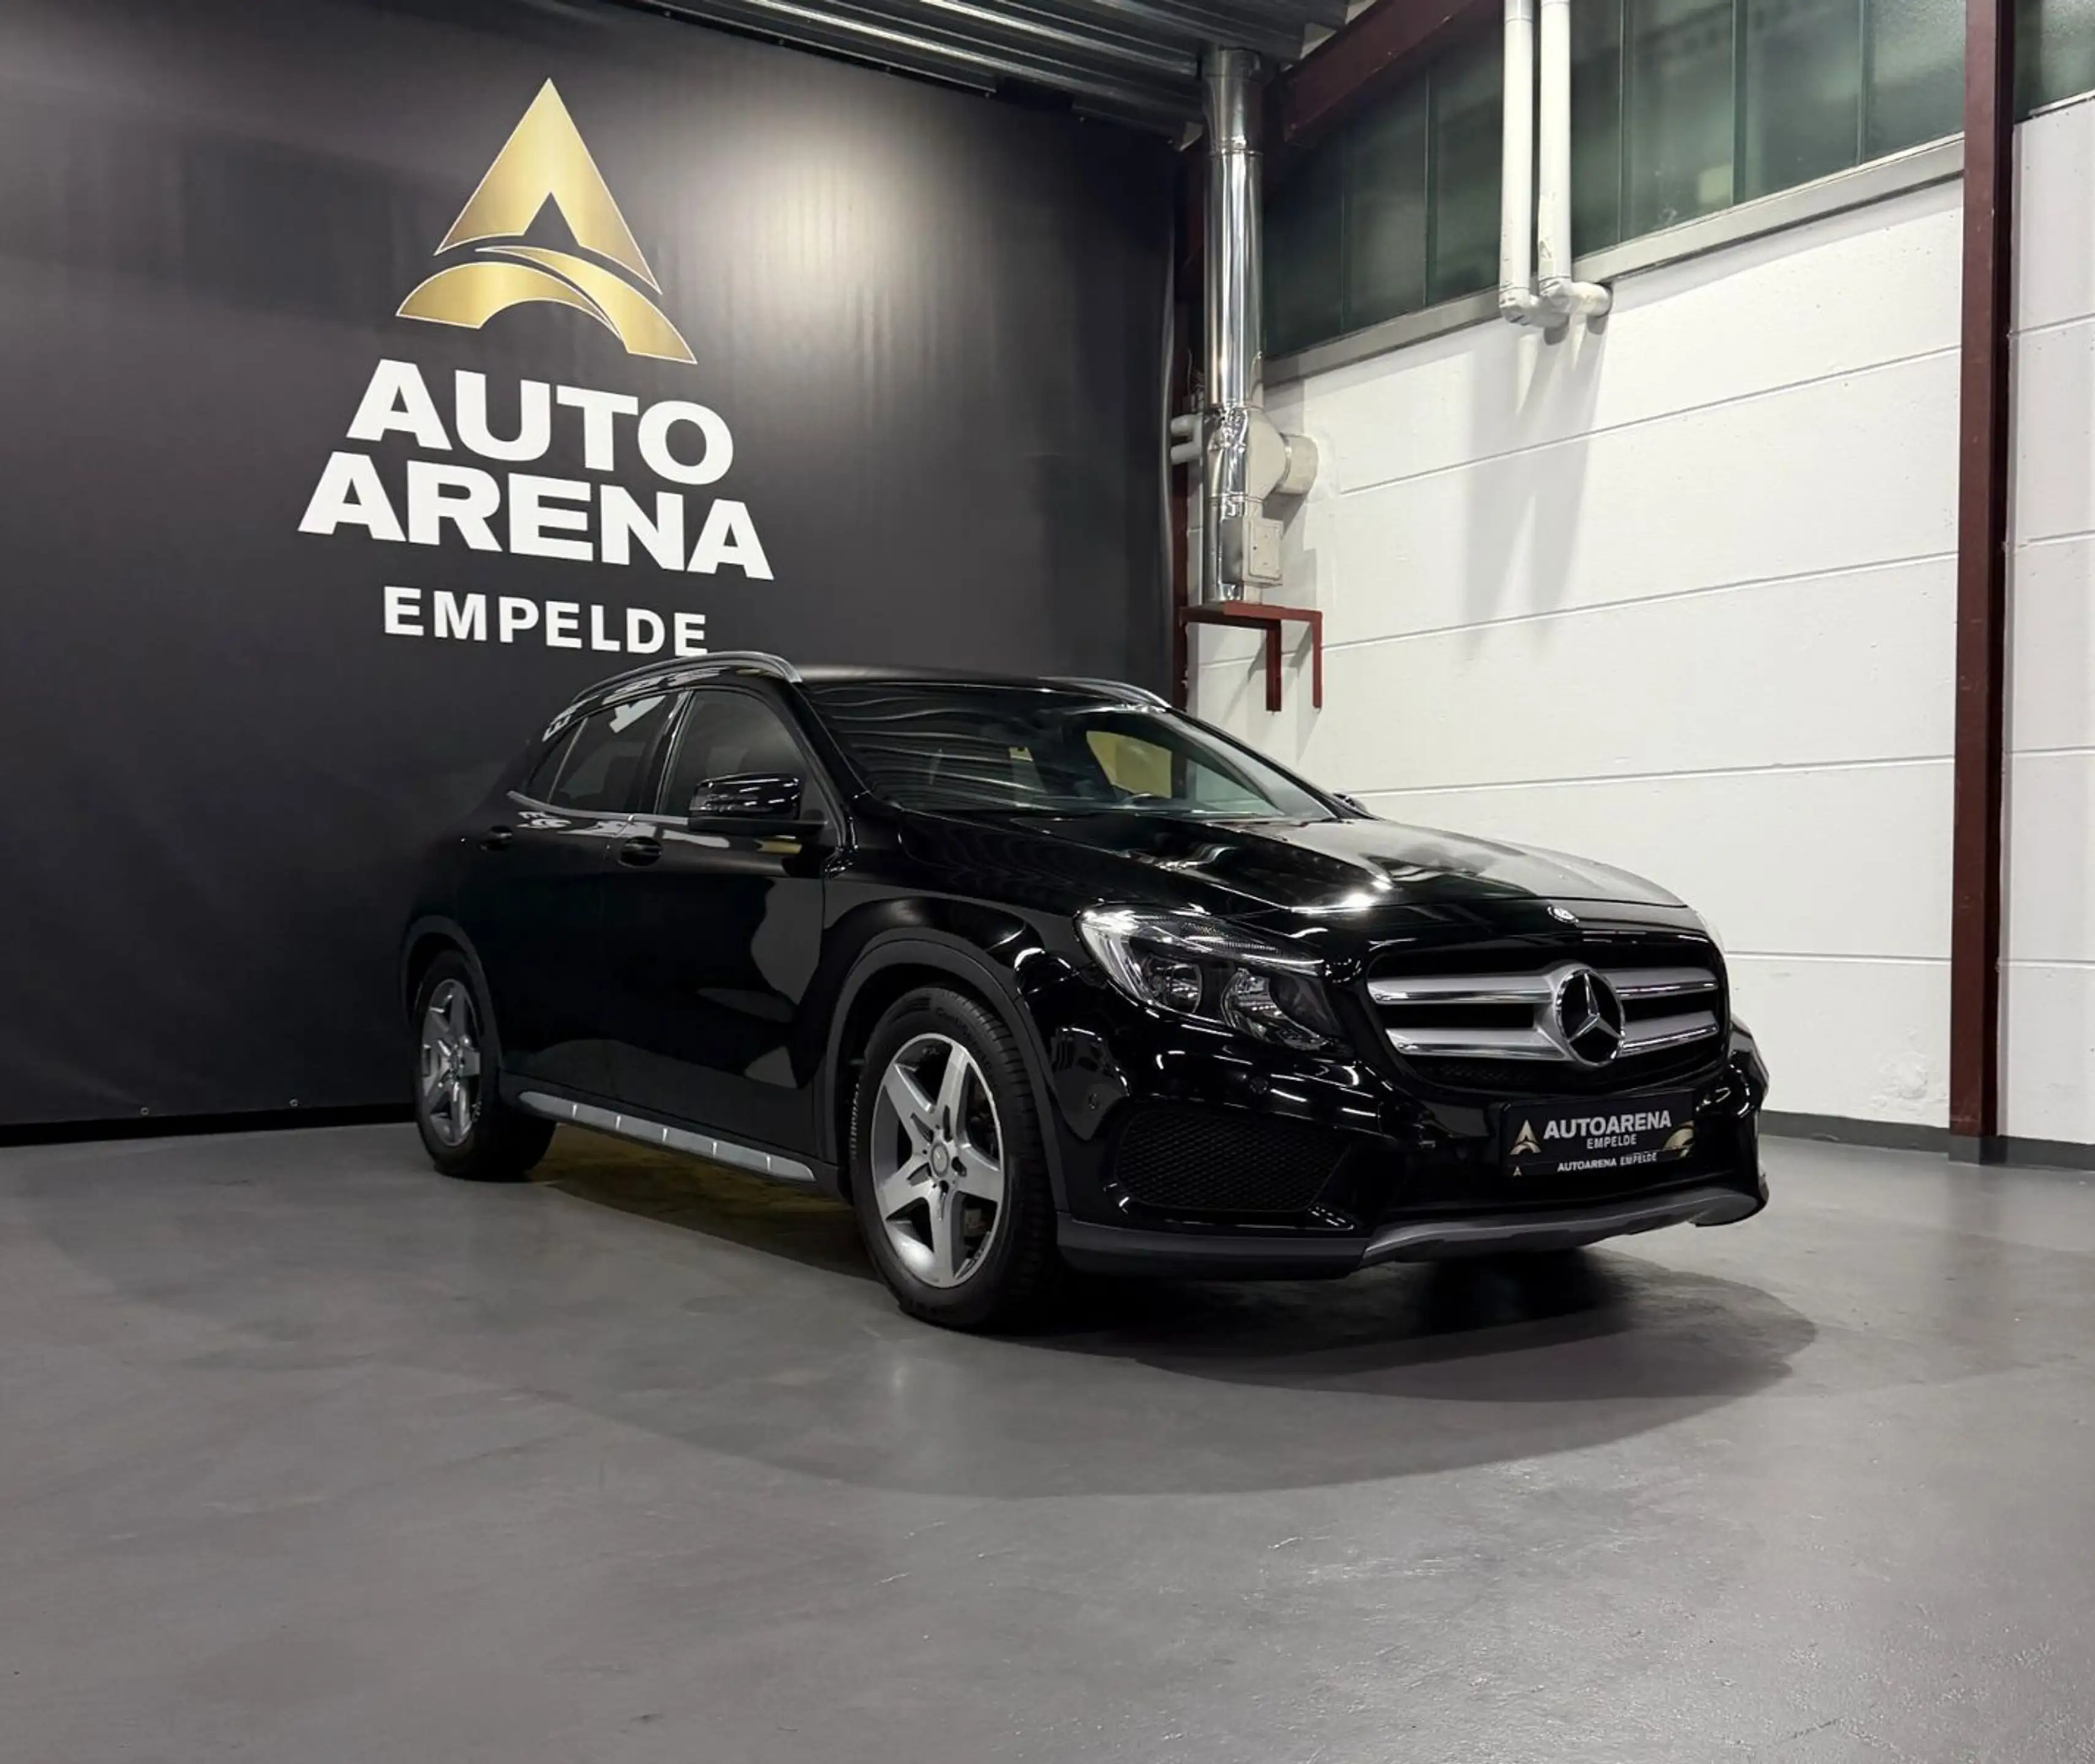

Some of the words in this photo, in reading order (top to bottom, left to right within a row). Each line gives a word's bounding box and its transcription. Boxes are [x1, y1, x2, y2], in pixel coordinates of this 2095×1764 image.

[346, 359, 734, 485] AUTO
[298, 451, 774, 581] ARENA
[384, 586, 708, 656] EMPELDE
[1543, 1110, 1672, 1140] AUTOARENA
[1586, 1133, 1637, 1150] EMPELDE
[1557, 1158, 1617, 1172] AUTOARENA
